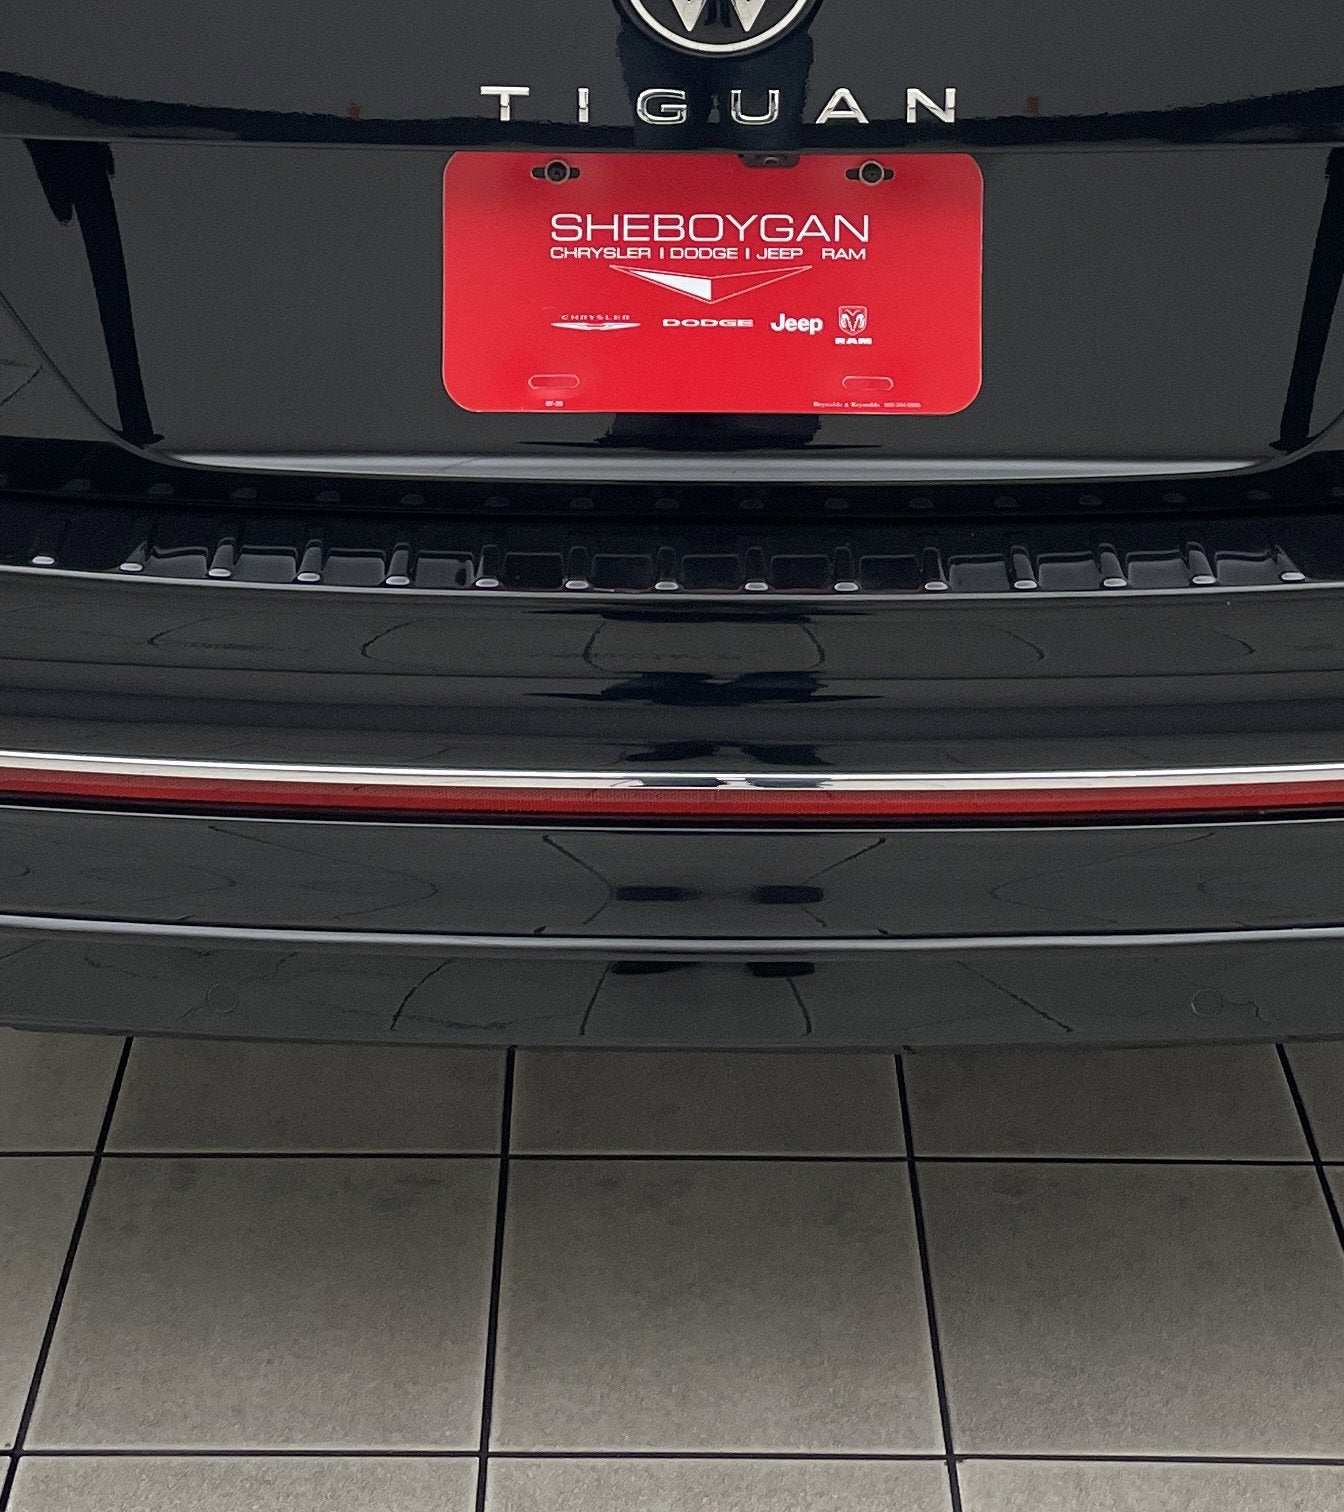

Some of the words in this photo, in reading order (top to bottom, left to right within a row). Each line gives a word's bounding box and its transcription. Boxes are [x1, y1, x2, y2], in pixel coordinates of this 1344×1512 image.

[479, 85, 957, 125] TIGUAN
[550, 213, 869, 243] SHEBOYGAN
[550, 247, 652, 260] CHRYSLER
[669, 247, 739, 261] DODGE
[756, 247, 804, 260] JEEP
[821, 248, 867, 260] RAM
[662, 318, 754, 328] DODGE
[769, 313, 824, 336] Jeep
[834, 337, 873, 346] RAM
